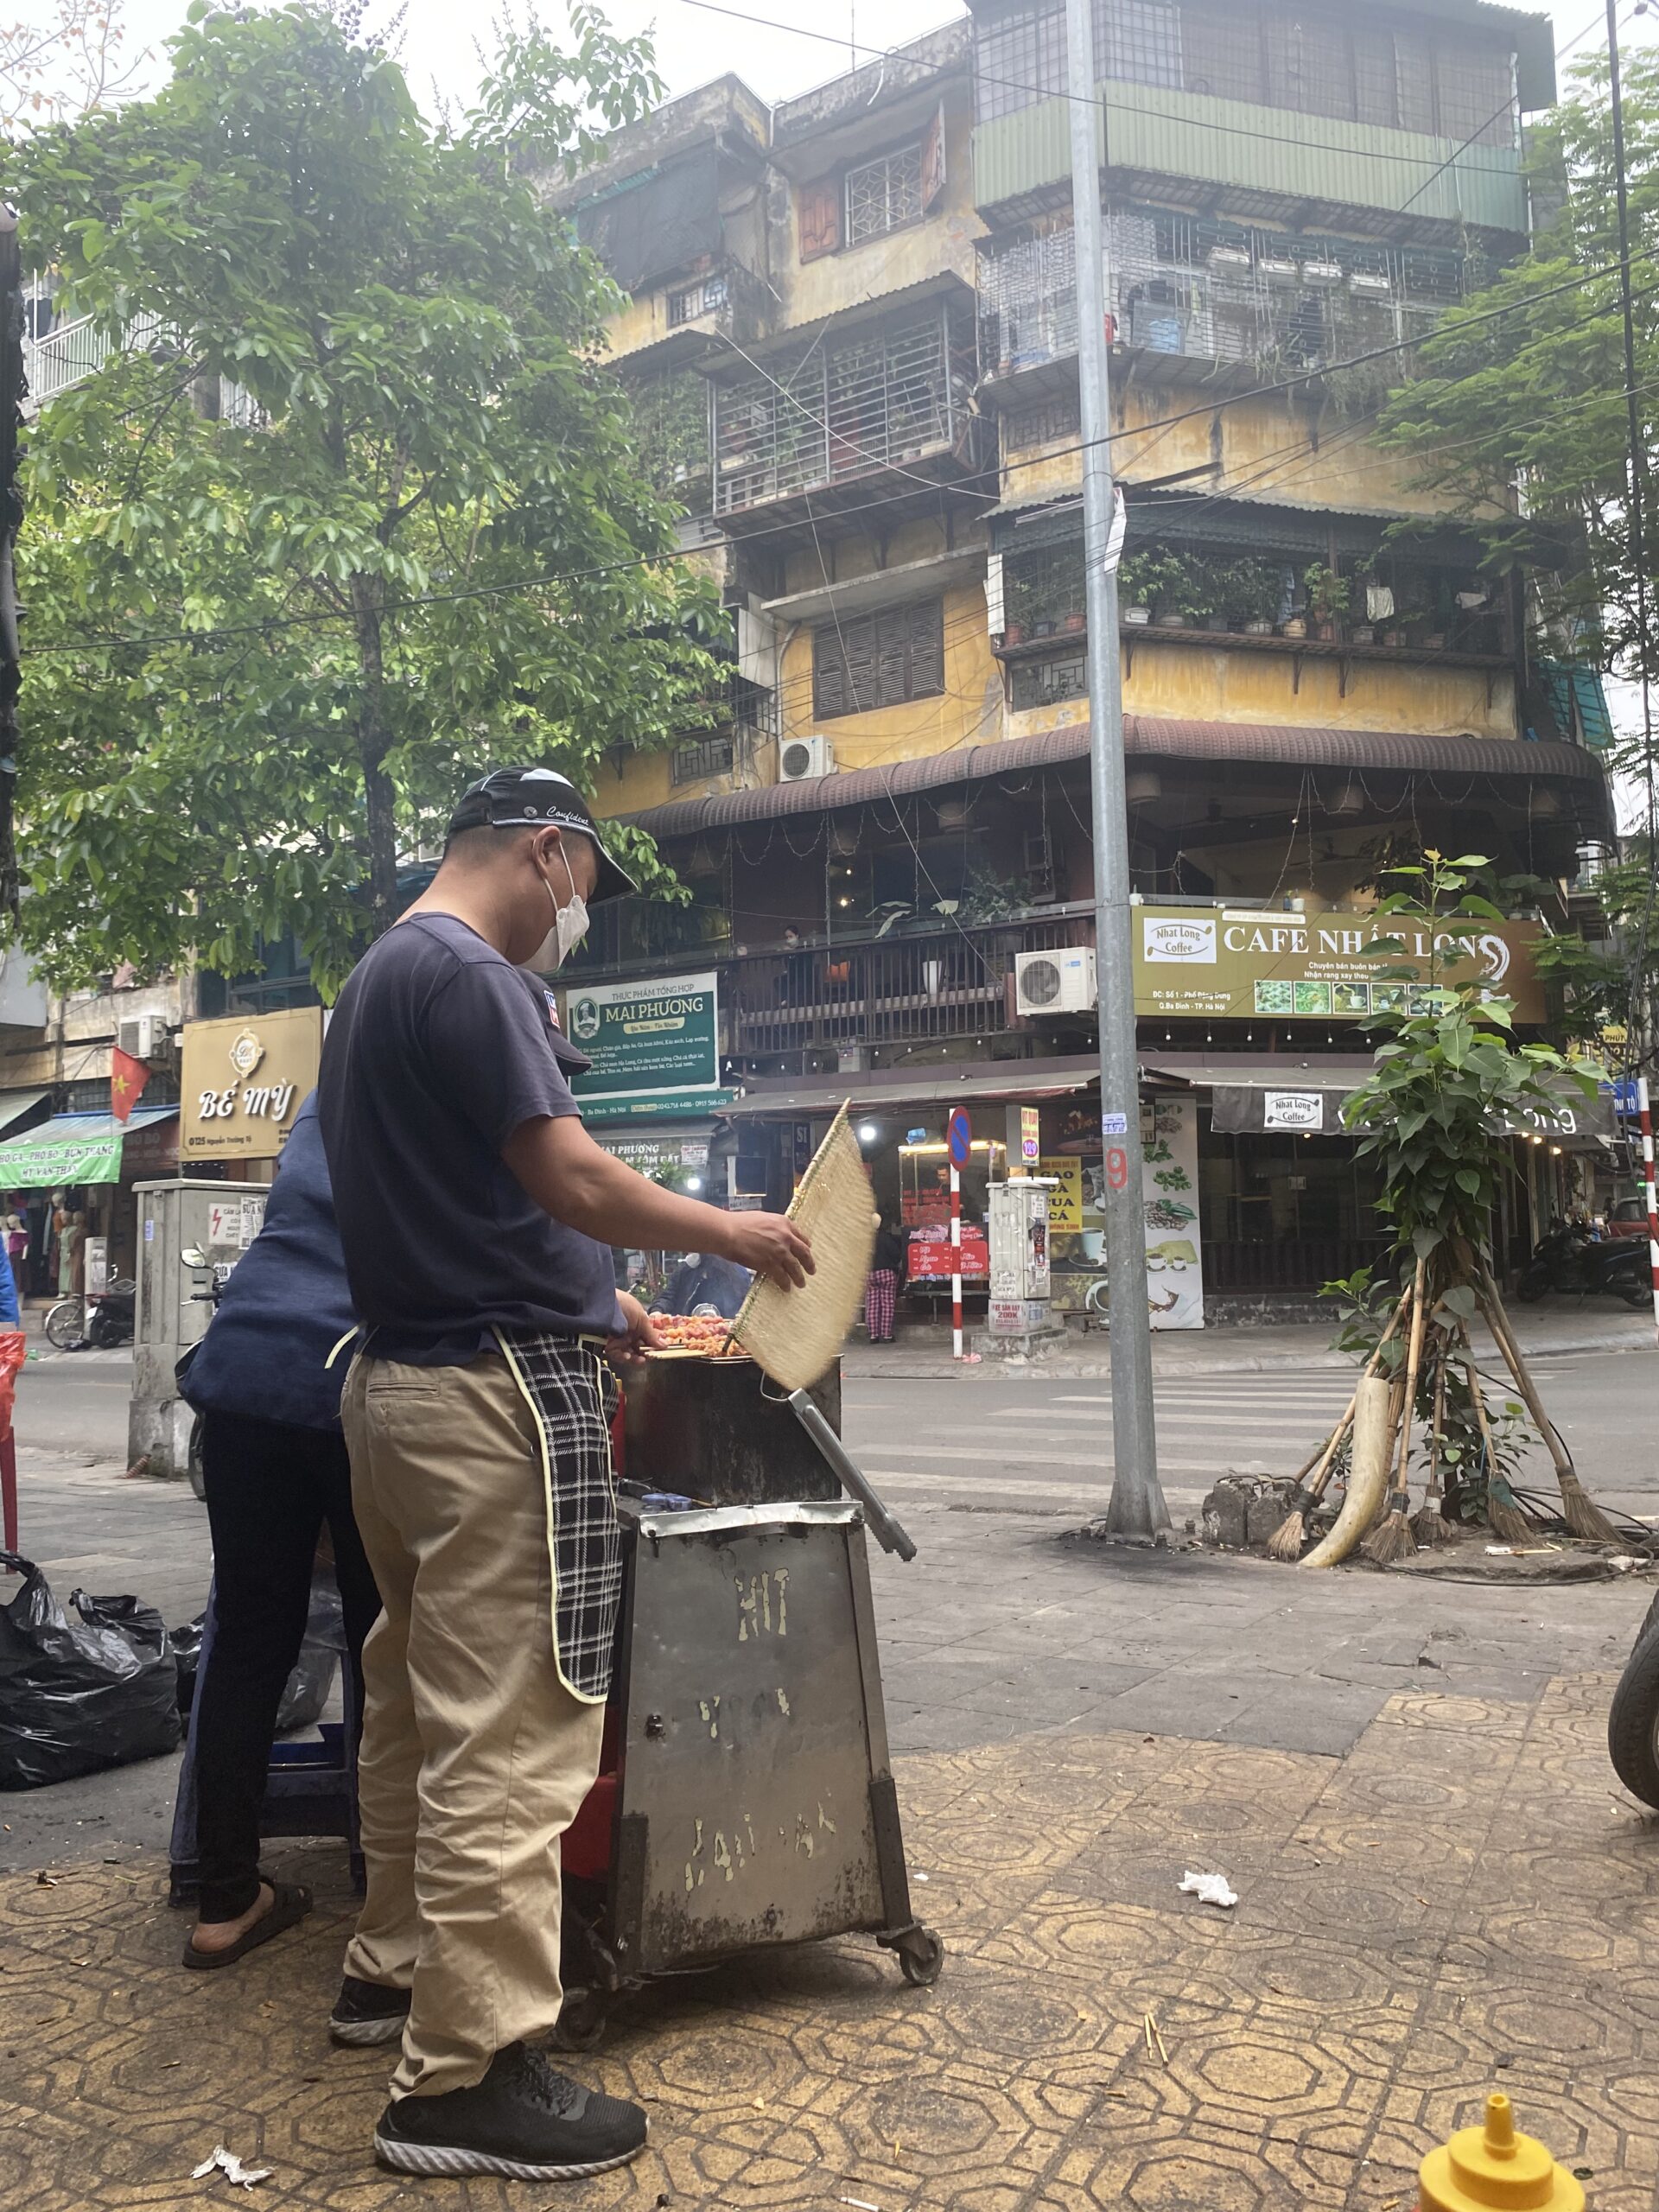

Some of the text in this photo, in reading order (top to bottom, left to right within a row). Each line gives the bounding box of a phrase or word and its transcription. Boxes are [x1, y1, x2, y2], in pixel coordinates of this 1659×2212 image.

[546, 805, 589, 826] Confident
[1156, 926, 1201, 941] Nhat Long
[1224, 926, 1309, 954] CAFE
[1166, 942, 1192, 953] Coffee
[605, 997, 703, 1022] MAI PHƯƠNG
[197, 1079, 240, 1119] BÉ
[1275, 1100, 1311, 1112] Nhat Long
[1282, 1111, 1306, 1121] Coffee
[1106, 1147, 1128, 1189] 9
